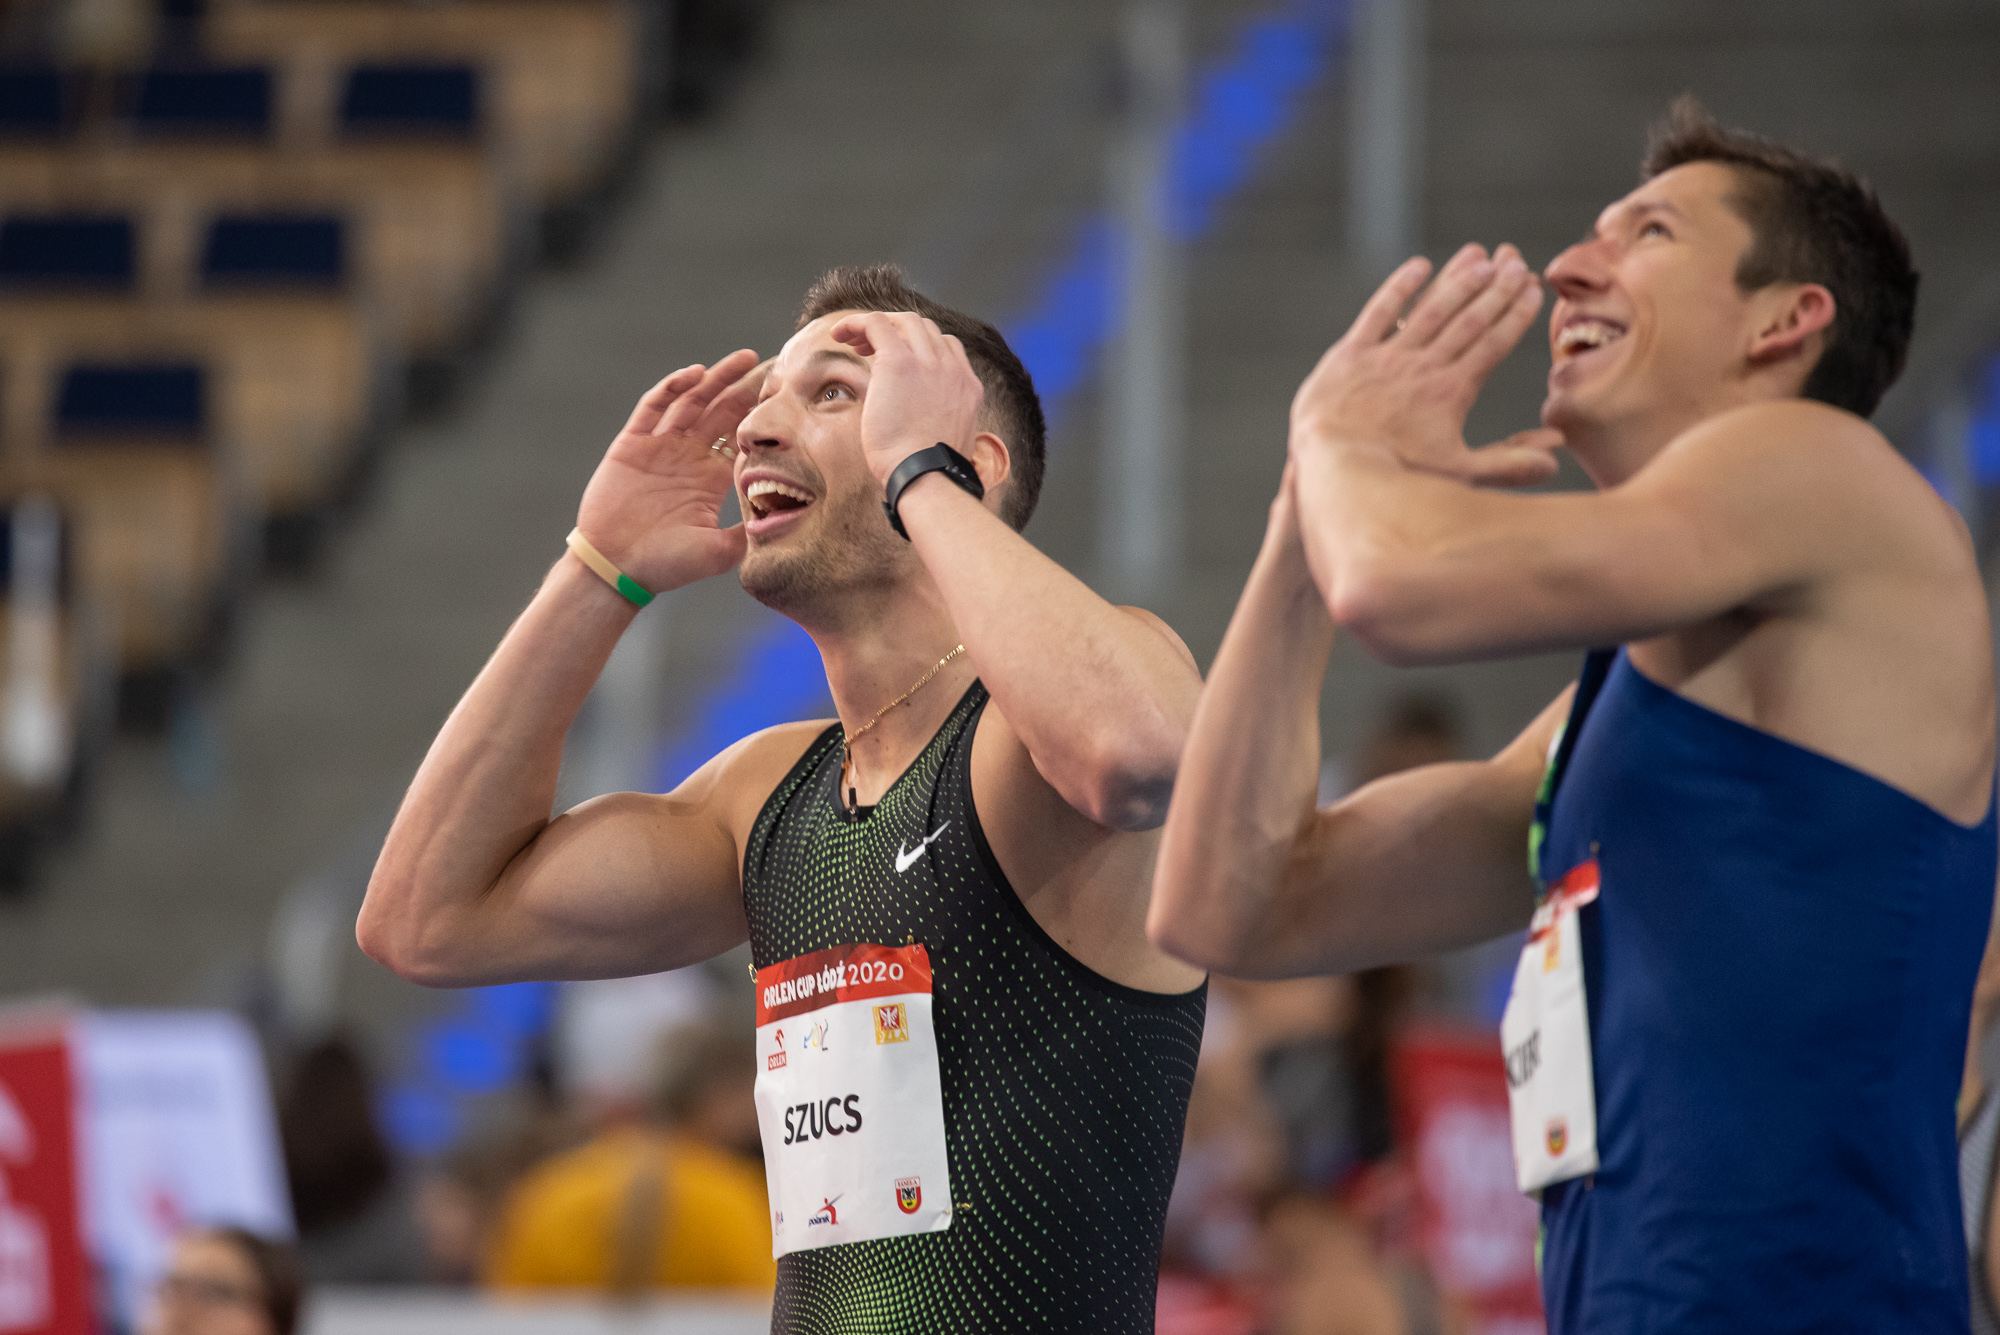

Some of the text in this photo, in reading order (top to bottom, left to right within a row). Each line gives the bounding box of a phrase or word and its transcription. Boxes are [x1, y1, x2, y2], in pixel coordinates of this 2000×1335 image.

[764, 960, 904, 1009] ORLEN CUP ŁÓDŹ 2020
[769, 1053, 786, 1069] ORLEN
[784, 1094, 862, 1145] SZUCS
